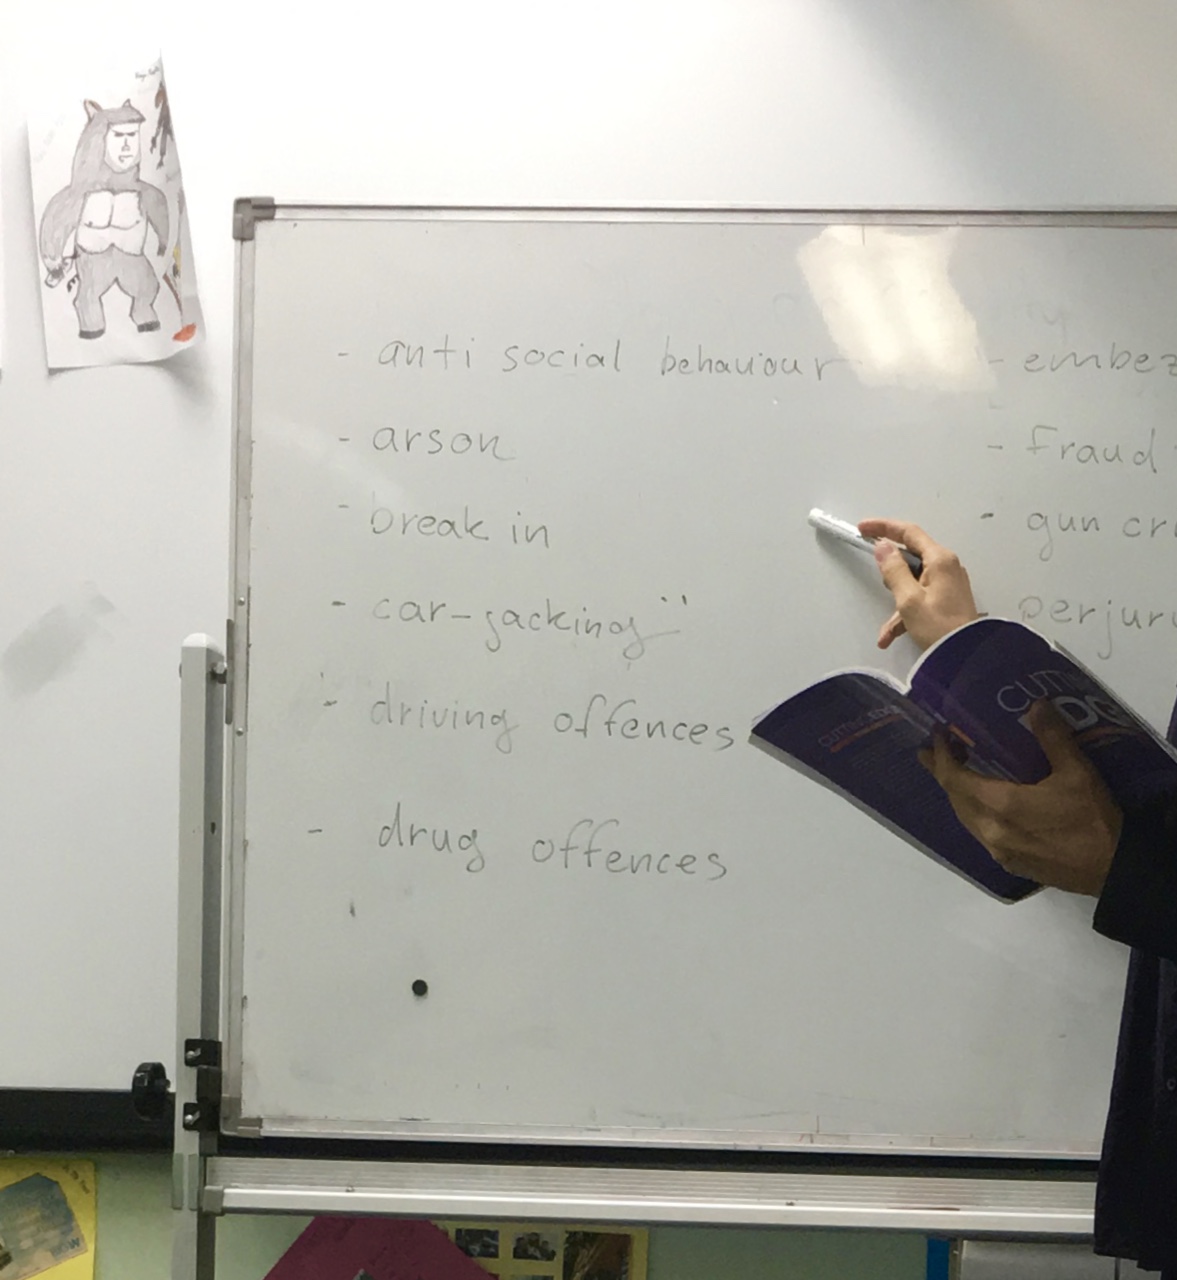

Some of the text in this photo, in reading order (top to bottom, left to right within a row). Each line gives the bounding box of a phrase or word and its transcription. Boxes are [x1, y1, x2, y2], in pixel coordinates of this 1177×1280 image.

[378, 333, 863, 382] anti social behaviour
[373, 425, 516, 461] arson
[370, 490, 550, 550] break in
[1026, 511, 1101, 562] gun
[370, 681, 735, 754] driving offences
[378, 801, 728, 881] drug offences
